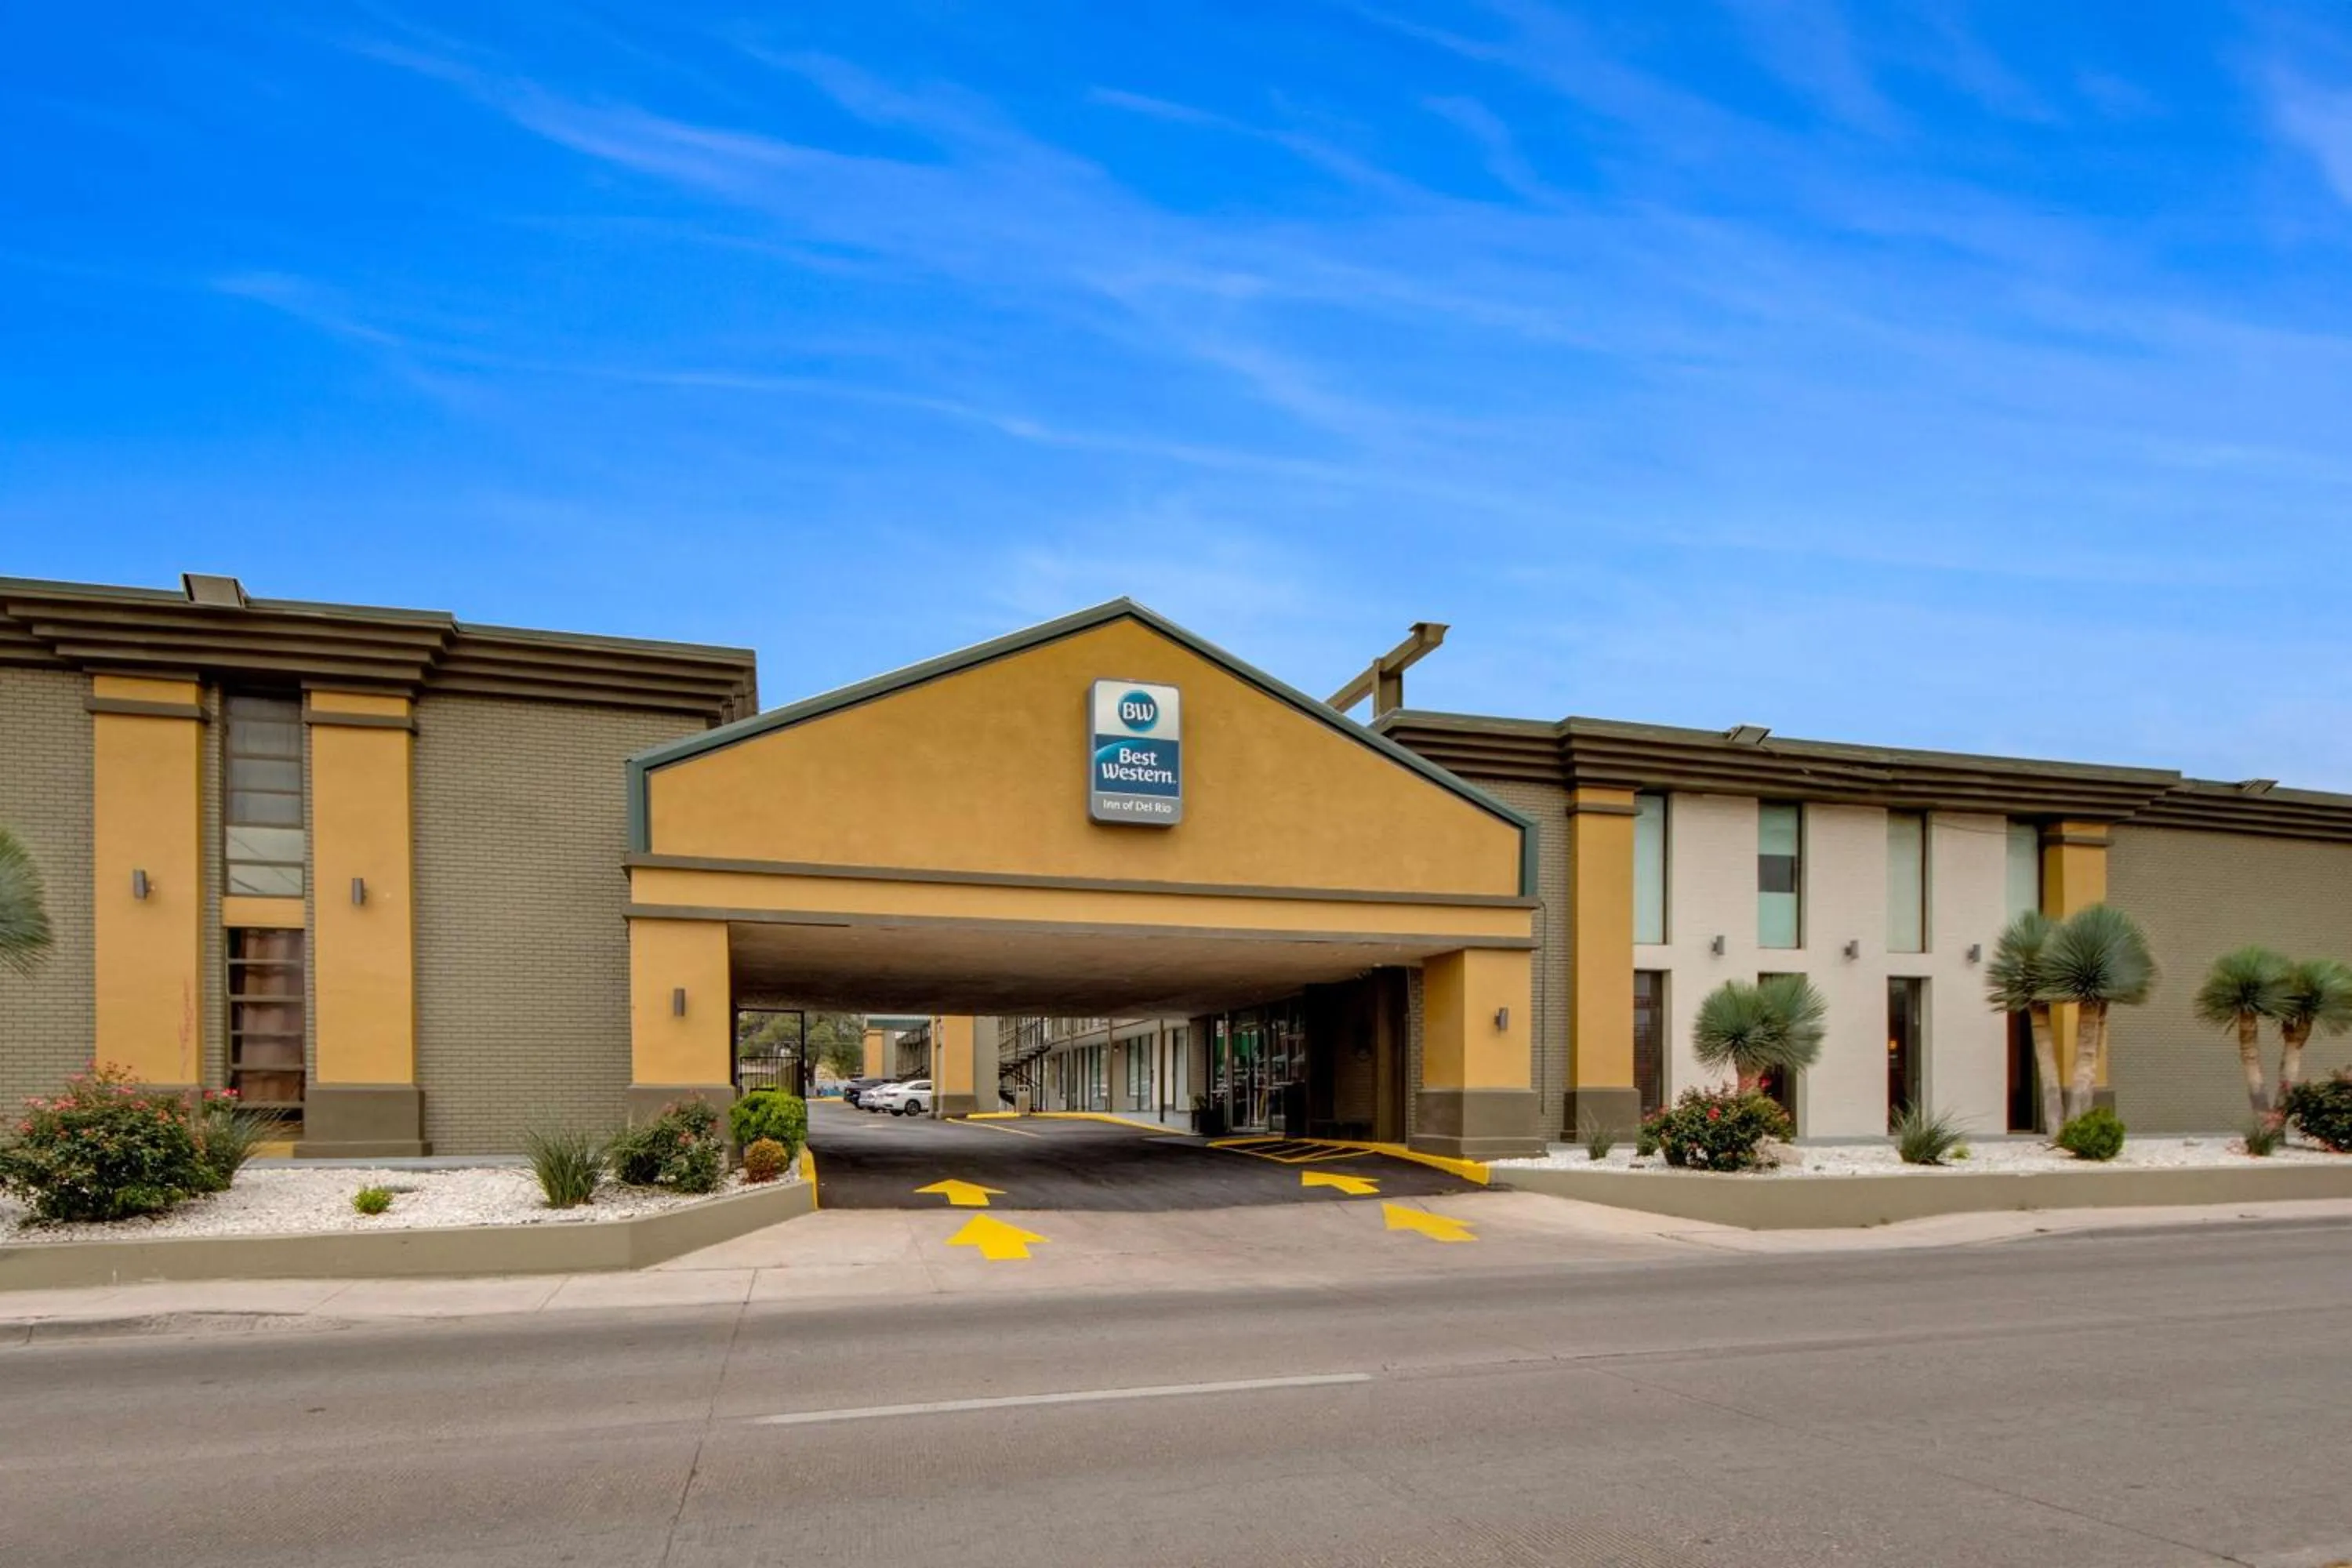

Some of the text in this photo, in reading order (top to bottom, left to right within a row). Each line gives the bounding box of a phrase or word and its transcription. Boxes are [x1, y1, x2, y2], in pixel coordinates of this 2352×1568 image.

[1123, 702, 1155, 721] BW
[1120, 748, 1157, 766] Best
[1102, 763, 1173, 783] Western
[1102, 799, 1172, 814] Inn of Del Rio
